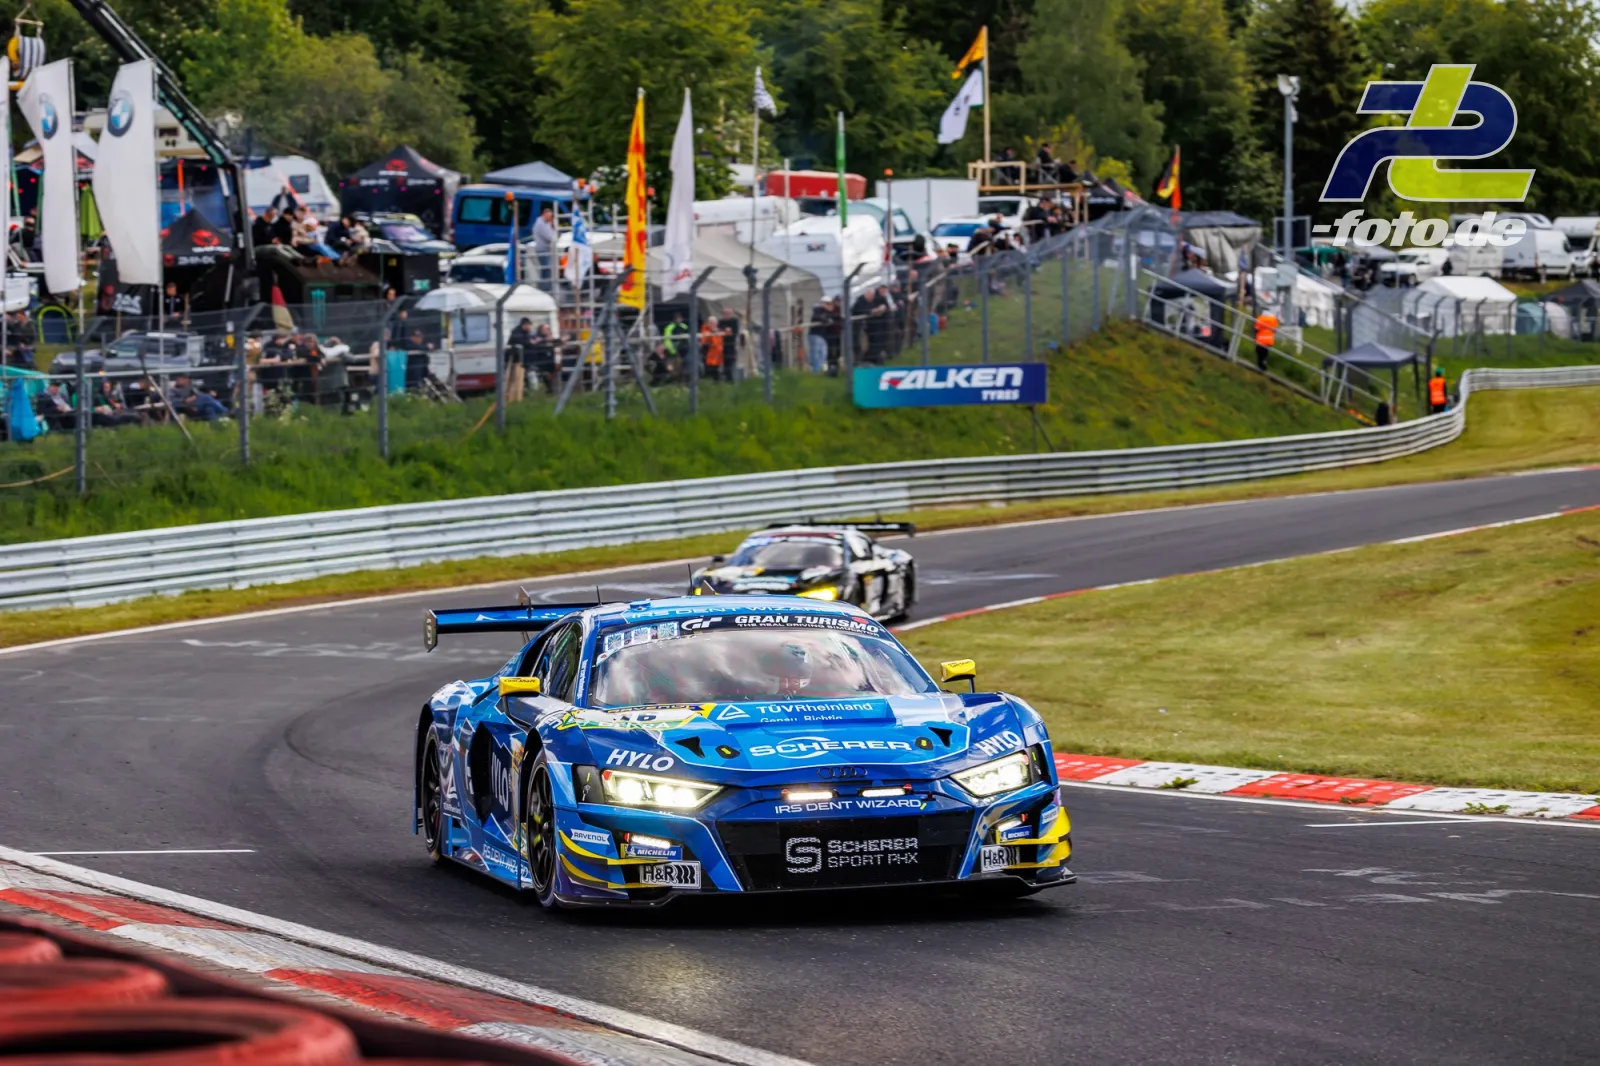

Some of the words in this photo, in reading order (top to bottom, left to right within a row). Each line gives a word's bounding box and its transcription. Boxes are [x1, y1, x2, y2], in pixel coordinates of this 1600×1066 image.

[879, 366, 1024, 391] FALKEN
[981, 389, 1020, 401] TYRES
[735, 614, 789, 625] GRAN
[794, 615, 879, 634] TURISMO
[827, 625, 880, 638] SIMULATOR
[749, 739, 913, 758] SCHERER
[974, 731, 1023, 757] HYLO
[606, 748, 675, 772] HYLO
[774, 804, 803, 814] IRS
[806, 801, 853, 812] DENT
[855, 799, 921, 809] WIZARD
[573, 831, 607, 842] RAVENOL
[636, 848, 678, 857] MICHELIN
[827, 837, 919, 854] SCHERER
[827, 854, 884, 868] SPORT
[887, 852, 919, 866] PHX
[983, 845, 1006, 868] H&R
[643, 864, 677, 882] H&R
